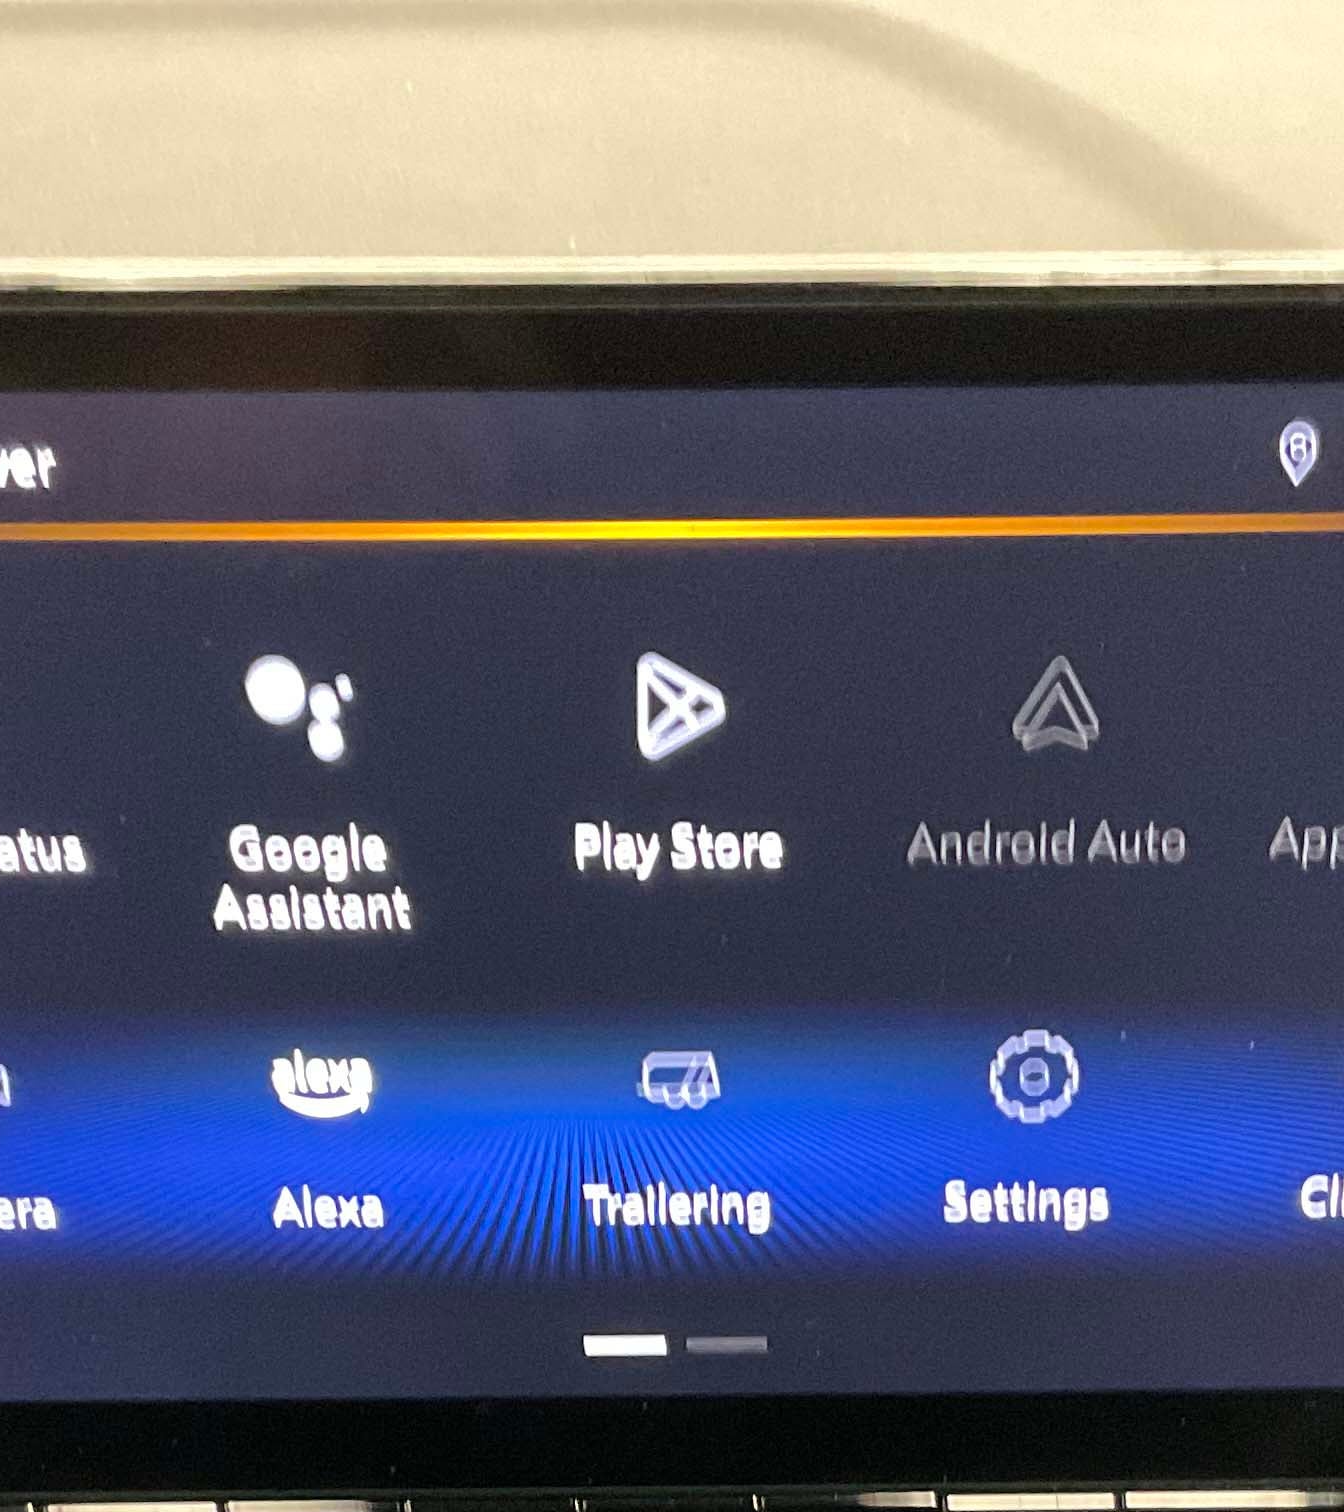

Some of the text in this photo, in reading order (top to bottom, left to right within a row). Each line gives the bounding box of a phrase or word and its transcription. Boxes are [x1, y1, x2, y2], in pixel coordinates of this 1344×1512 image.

[228, 822, 388, 882] Google
[573, 820, 785, 882] Play Store
[906, 818, 1188, 866] Android Auto
[212, 885, 413, 932] Assistant
[271, 1183, 386, 1230] Alexa
[582, 1180, 772, 1236] Trailering
[942, 1179, 1110, 1232] Settings
